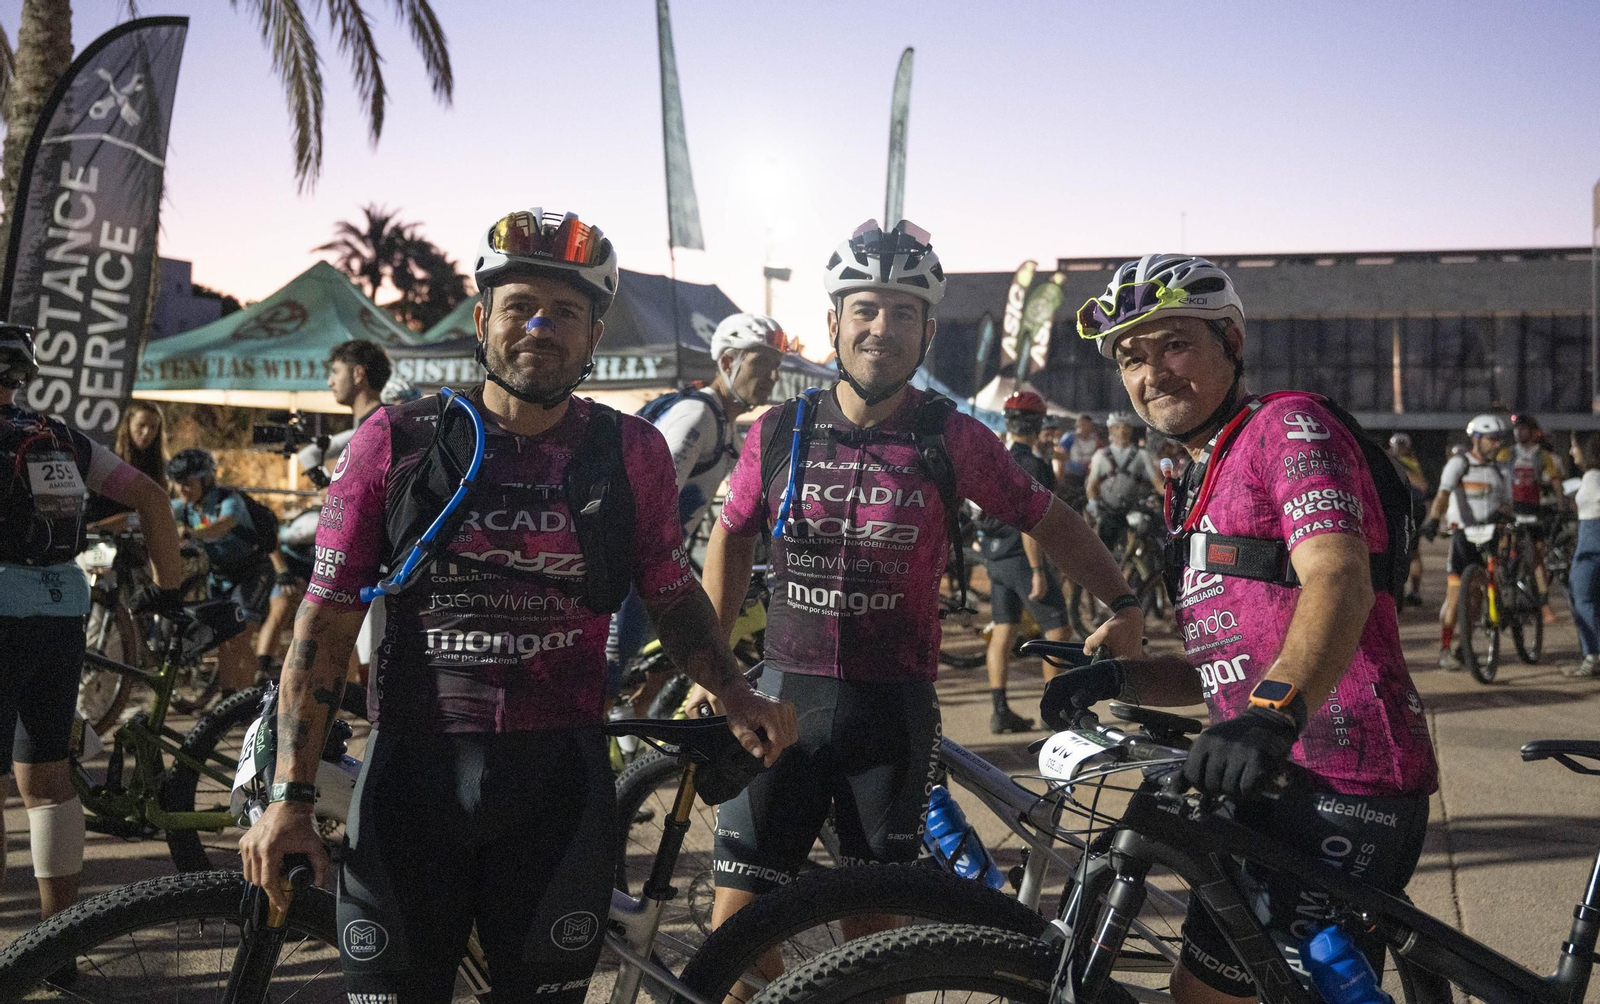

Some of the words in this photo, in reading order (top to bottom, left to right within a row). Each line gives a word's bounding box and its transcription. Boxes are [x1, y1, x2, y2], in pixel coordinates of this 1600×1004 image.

[26, 160, 98, 416] SISTANCE
[75, 220, 138, 432] SERVICE
[394, 358, 487, 382] SISTE
[594, 356, 662, 381] ILLY
[786, 598, 809, 612] higiene
[809, 605, 821, 615] por
[787, 581, 905, 616] mongar
[426, 628, 584, 660] mongar
[1220, 633, 1243, 646] estudio
[1316, 795, 1399, 829] ideallpack
[716, 859, 792, 886] NUTRICIÓ
